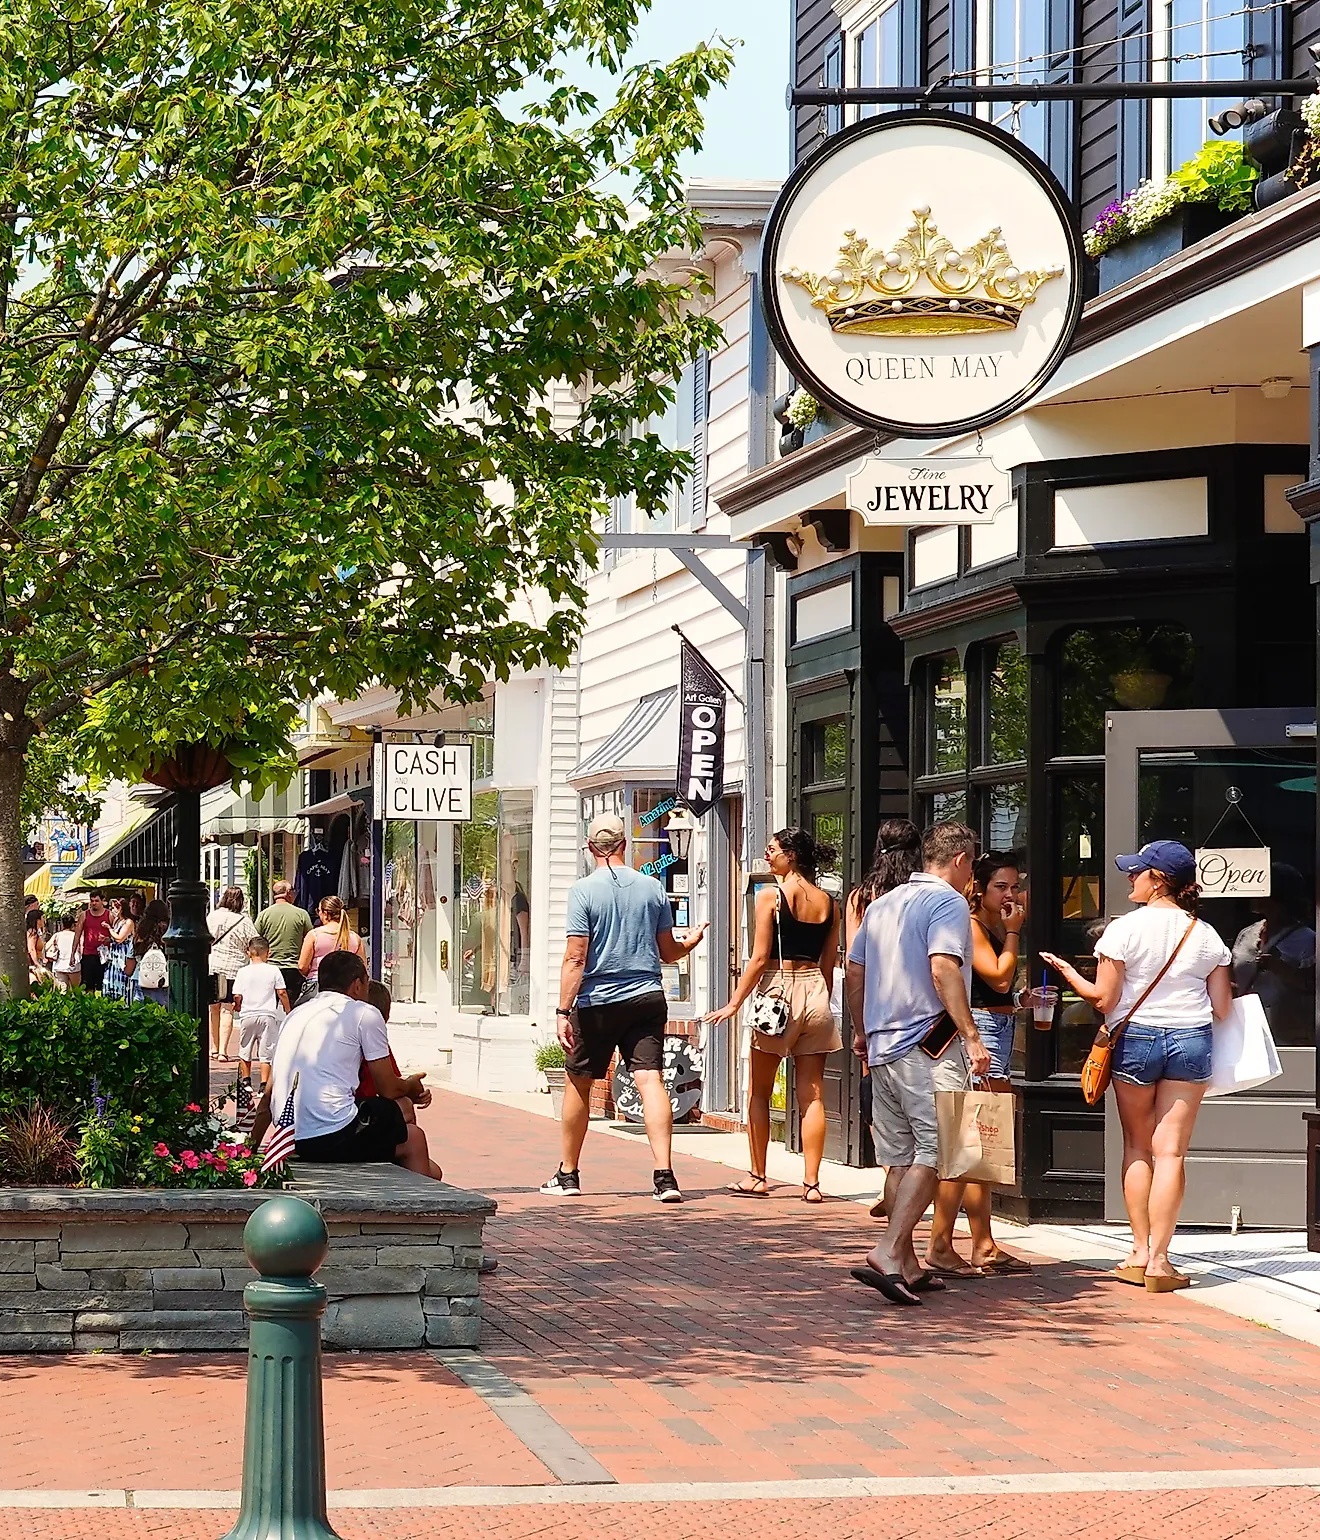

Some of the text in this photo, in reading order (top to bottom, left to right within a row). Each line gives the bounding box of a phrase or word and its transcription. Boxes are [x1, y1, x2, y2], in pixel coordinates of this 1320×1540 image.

[845, 355, 1003, 386] QUEEN MAY
[908, 467, 947, 481] Fine
[866, 484, 994, 514] JEWELRY
[684, 693, 722, 706] Art Gallery
[394, 749, 457, 776] CASH
[687, 706, 717, 802] OPEN
[394, 777, 408, 785] AND
[394, 786, 463, 813] CLIVE
[639, 797, 676, 828] Amazing
[306, 864, 331, 875] CAPE MAY
[1198, 853, 1268, 894] Open
